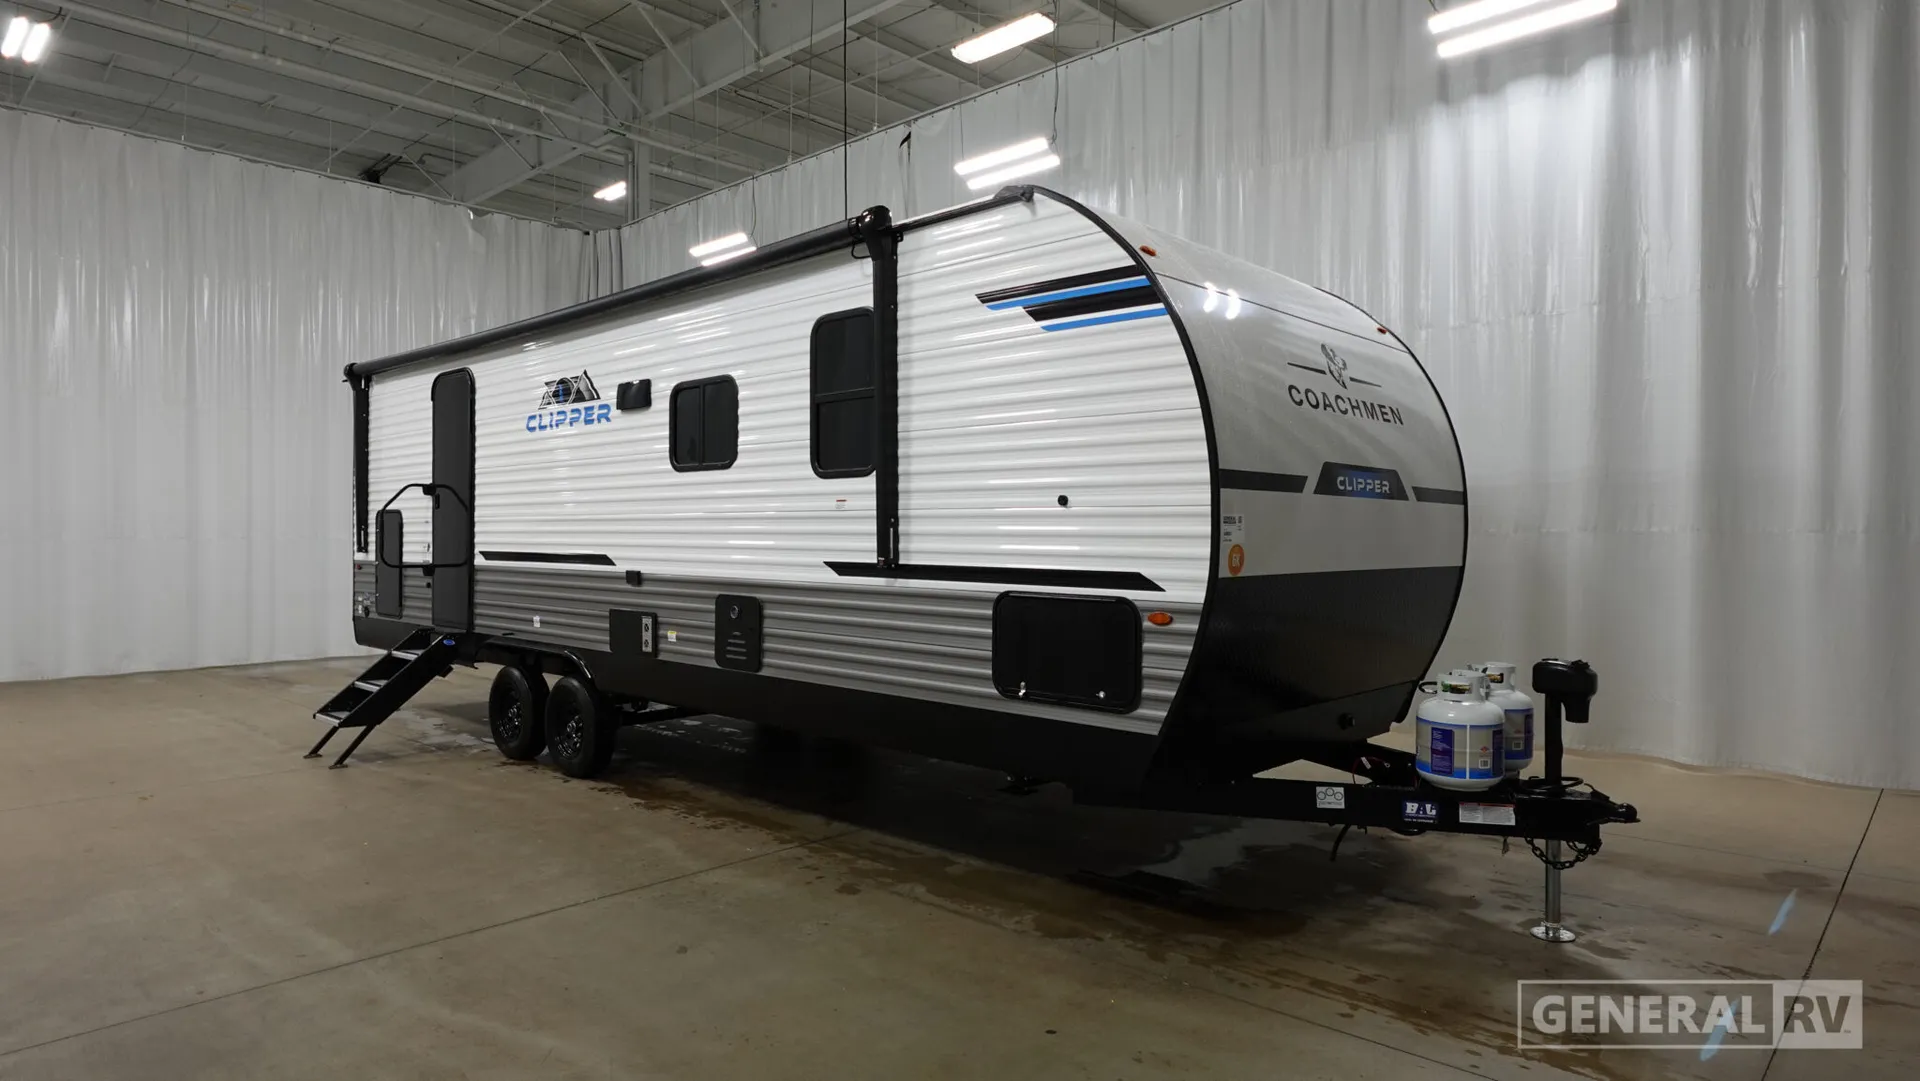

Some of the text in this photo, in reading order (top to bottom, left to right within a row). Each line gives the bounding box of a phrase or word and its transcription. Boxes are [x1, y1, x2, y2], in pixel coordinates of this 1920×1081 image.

[526, 404, 611, 432] CLIPPER
[1288, 385, 1404, 425] COACHMEN
[1336, 476, 1390, 494] CLIPPER
